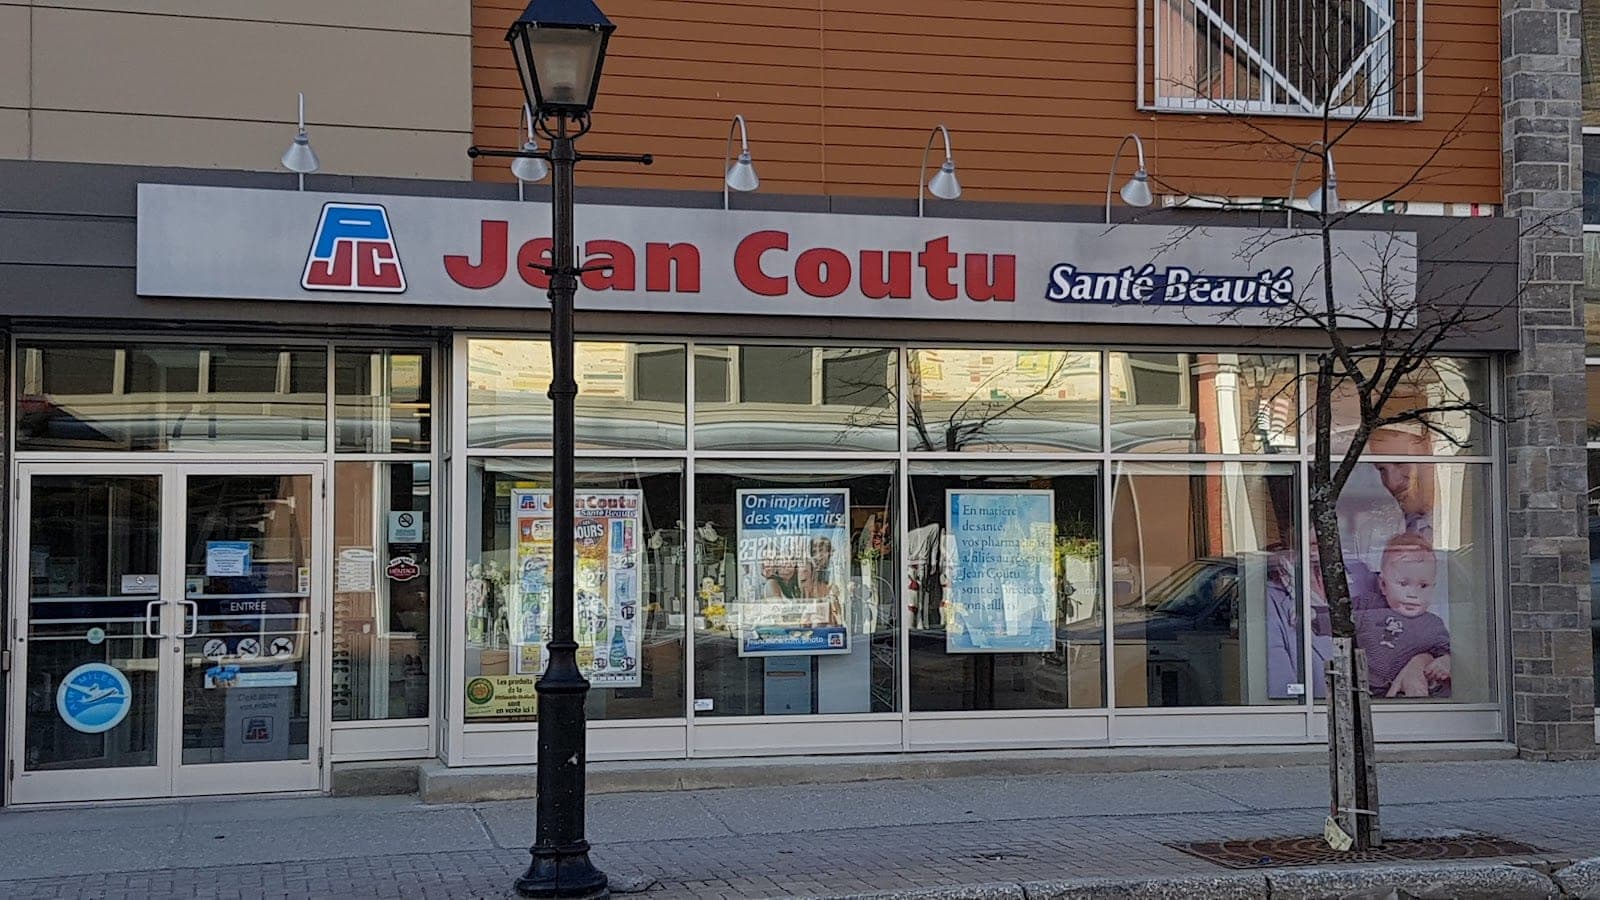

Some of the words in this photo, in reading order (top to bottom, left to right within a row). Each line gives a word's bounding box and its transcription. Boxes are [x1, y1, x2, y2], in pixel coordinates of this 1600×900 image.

[443, 219, 700, 293] Jean
[734, 230, 1016, 302] Coutu
[1049, 263, 1155, 301] Santé
[1164, 266, 1293, 305] Beauté
[587, 495, 637, 509] Coutu
[745, 495, 767, 508] On
[770, 495, 831, 511] imprime
[963, 504, 977, 516] En
[745, 511, 770, 524] des
[962, 520, 974, 531] de
[962, 539, 979, 547] vos
[961, 567, 984, 580] Jean
[986, 567, 1021, 580] Coutu
[961, 585, 984, 594] sont
[987, 583, 999, 594] de
[230, 600, 267, 612] ENTRÉE
